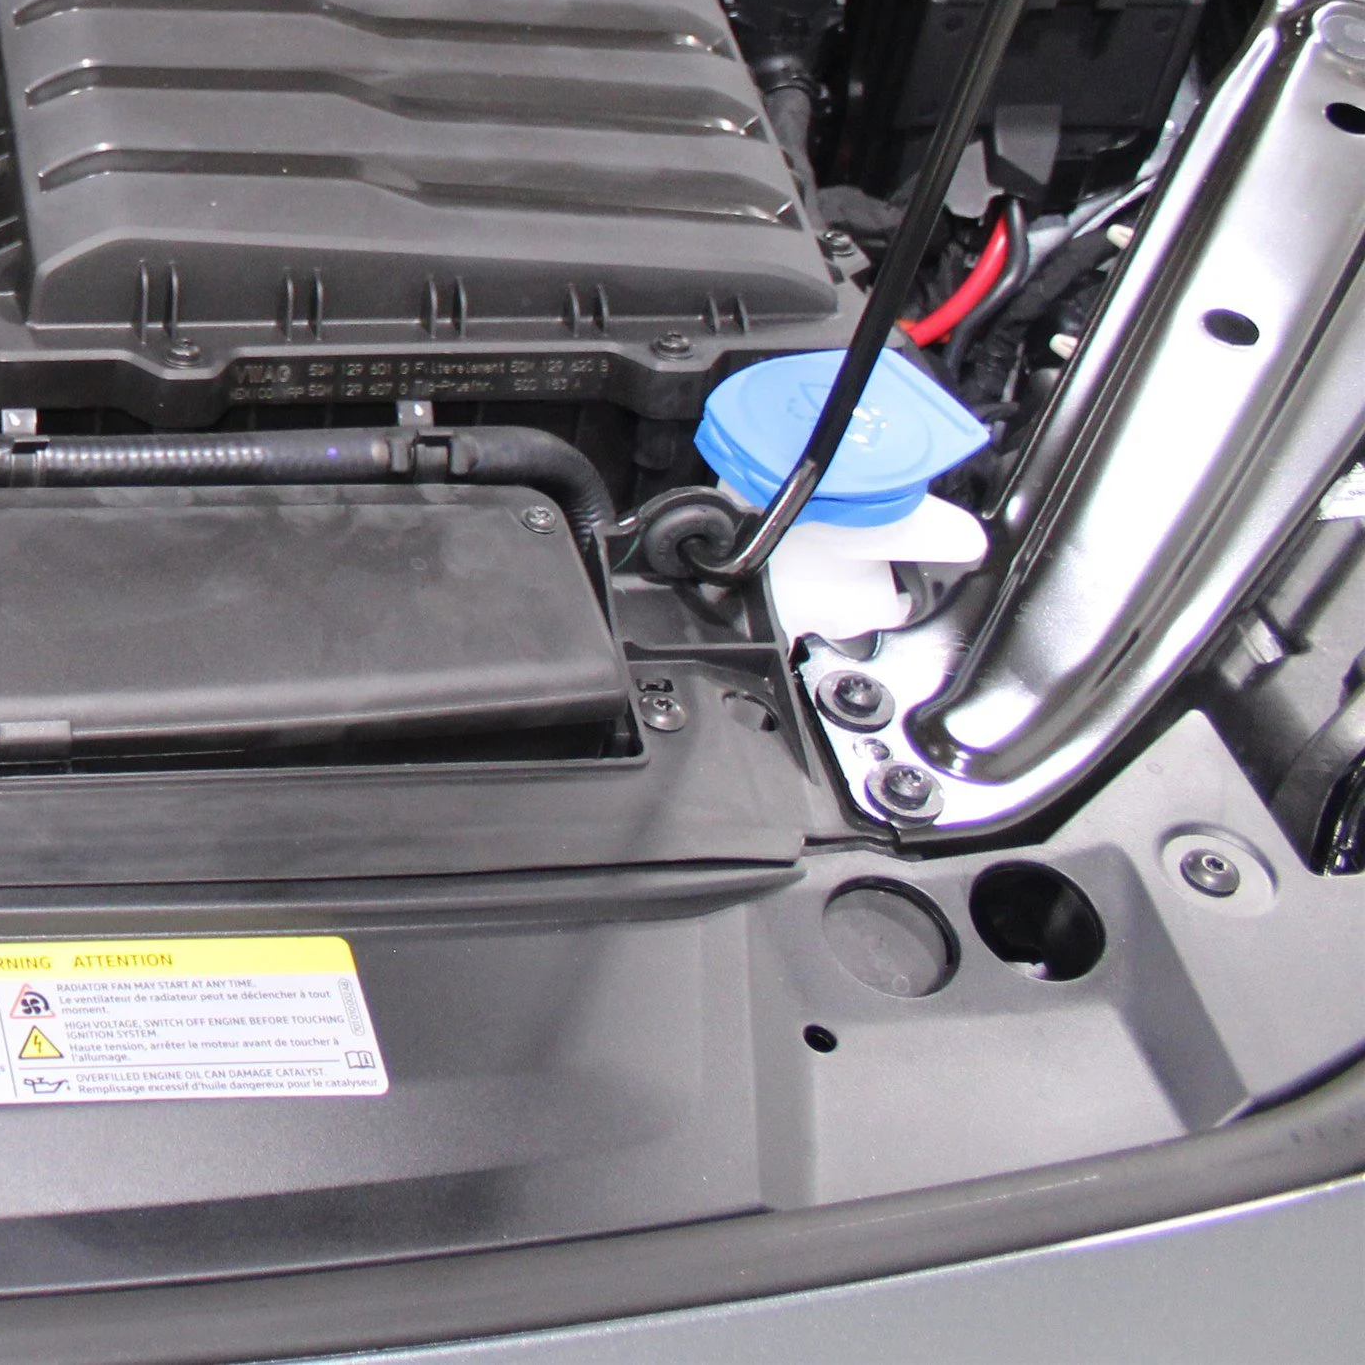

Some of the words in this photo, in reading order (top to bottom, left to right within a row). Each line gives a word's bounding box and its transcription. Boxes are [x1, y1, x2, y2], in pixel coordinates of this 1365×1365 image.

[72, 952, 174, 969] ATTENTION
[56, 982, 108, 992] RADIATOR
[110, 982, 132, 990] FAN
[133, 981, 156, 990] MAY
[158, 981, 189, 989] START
[190, 980, 203, 989] AT
[205, 979, 227, 988] ANY
[228, 979, 256, 987] TIME.
[58, 996, 71, 1004] Le
[74, 994, 132, 1003] ventilateur
[132, 993, 147, 1002] de
[148, 992, 198, 1002] radiateur
[199, 993, 225, 1002] peut
[239, 989, 297, 999] déclencher
[298, 989, 306, 998] à
[307, 989, 331, 998] tout
[60, 1006, 109, 1014] moment.
[63, 1021, 91, 1029] HIGH
[92, 1019, 142, 1030] VOLTAGE,
[142, 1018, 184, 1027] SWITCH
[185, 1018, 206, 1026] OFF
[207, 1017, 247, 1026] ENGINE
[248, 1016, 290, 1025] BEFORE
[290, 1015, 345, 1024] TOUCHING
[65, 1030, 114, 1039] IGNITION
[68, 1042, 102, 1052] Haute
[103, 1041, 148, 1052] tension,
[148, 1040, 186, 1050] arrêter
[187, 1040, 198, 1049] le
[200, 1040, 240, 1048] moteur
[241, 1039, 272, 1047] avant
[273, 1038, 288, 1046] de
[289, 1037, 330, 1046] toucher
[331, 1036, 339, 1045] à
[75, 1071, 141, 1082] OVERFILLED
[142, 1070, 183, 1080] ENGINE
[184, 1070, 202, 1079] OIL
[203, 1069, 226, 1079] CAN
[227, 1068, 273, 1078] DAMAGE
[274, 1067, 327, 1077] CATALYST.
[78, 1083, 145, 1095] Remplissage
[146, 1082, 190, 1092] excessif
[190, 1081, 227, 1090] d'huile
[230, 1080, 285, 1090] dangereux
[286, 1080, 311, 1089] pour
[312, 1079, 323, 1087] le
